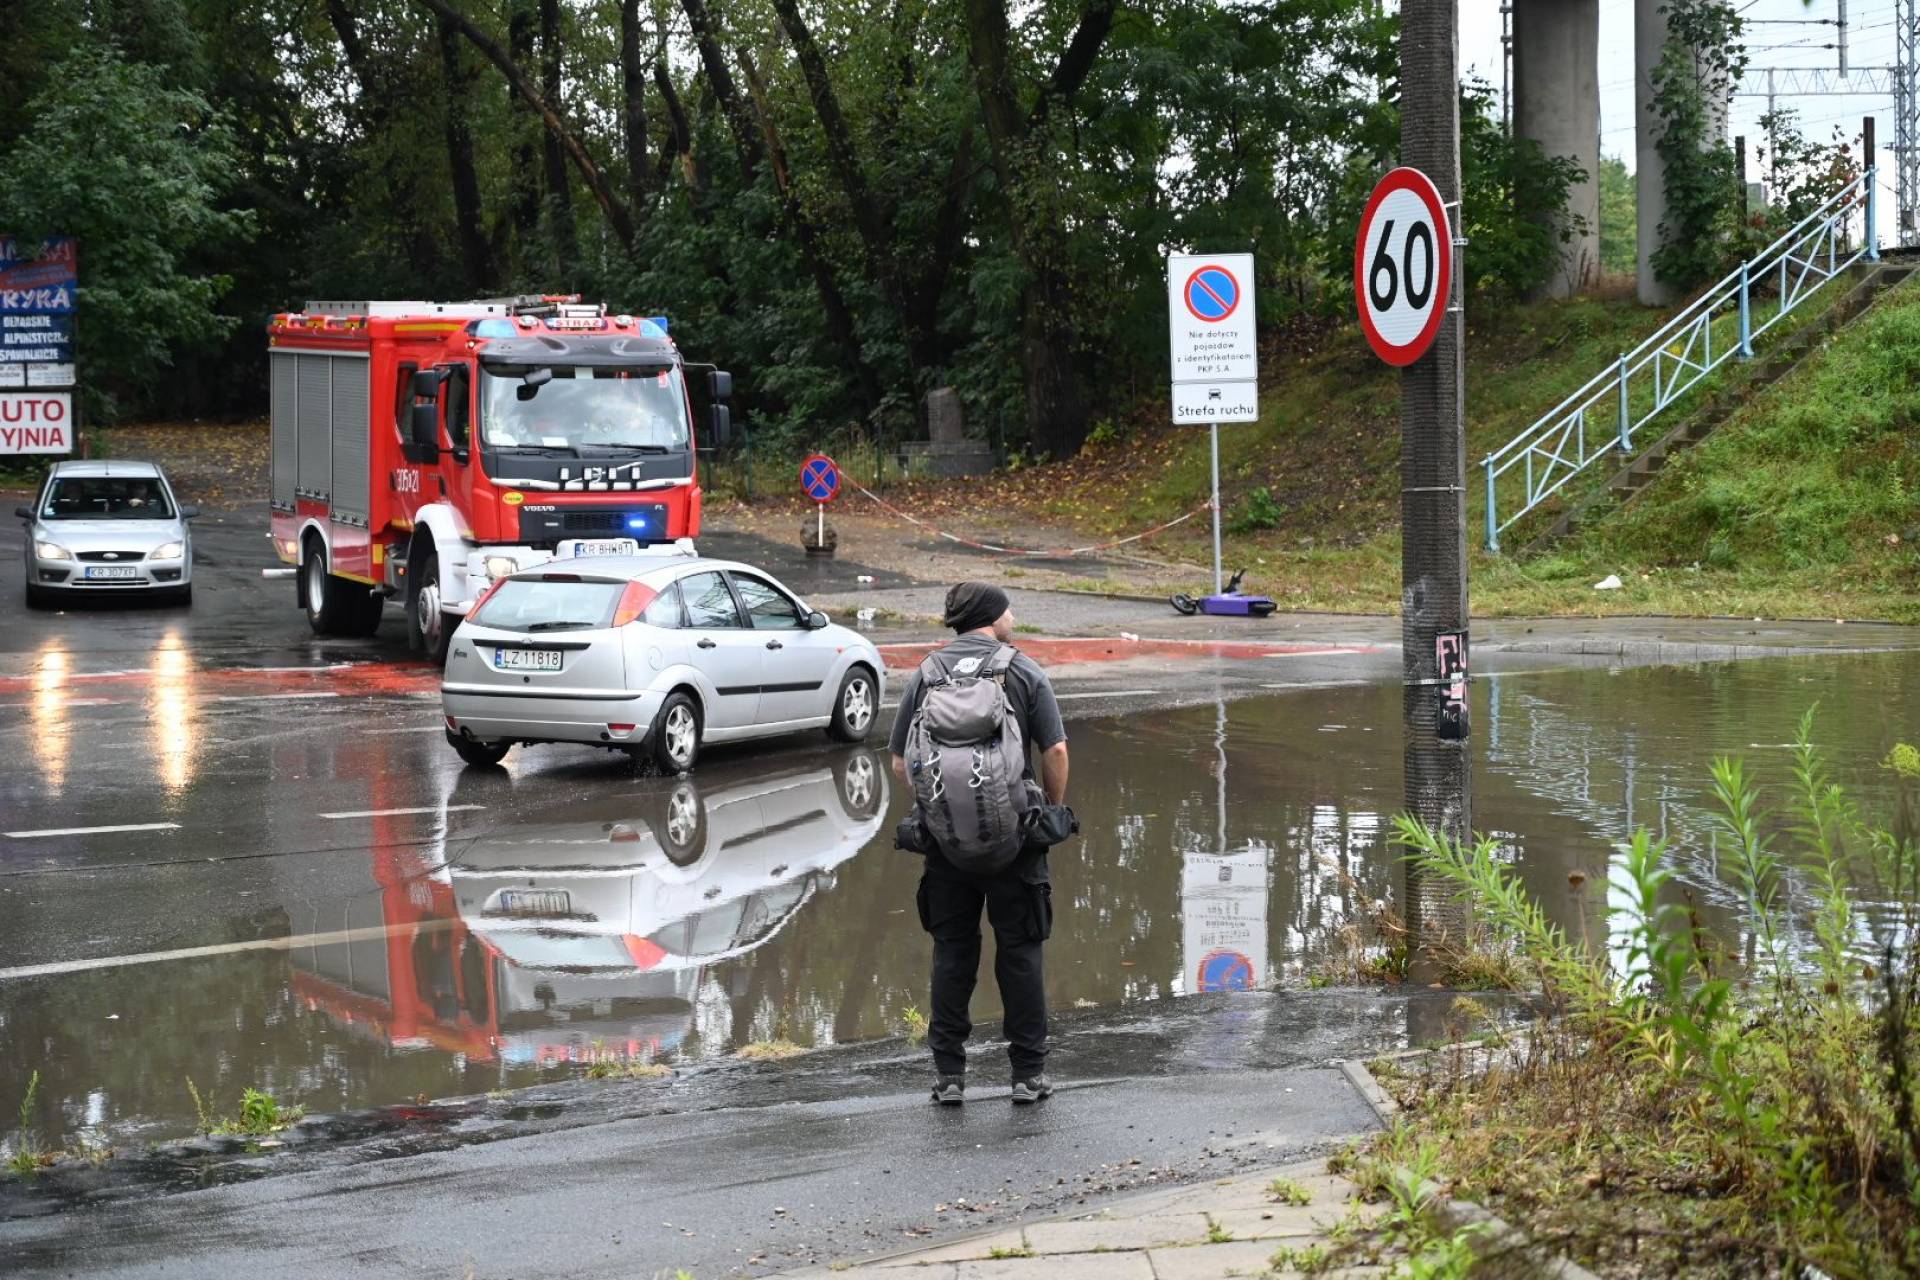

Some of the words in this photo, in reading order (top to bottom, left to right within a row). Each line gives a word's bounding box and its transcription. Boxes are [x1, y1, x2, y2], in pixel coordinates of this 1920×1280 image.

[1369, 219, 1433, 312] 60
[1197, 364, 1214, 374] PKP
[0, 399, 65, 422] UTO
[1178, 406, 1216, 417] Strefa
[1220, 403, 1255, 416] ruchu
[523, 505, 556, 513] VOLVO
[504, 650, 520, 665] LZ
[524, 651, 559, 666] 11818
